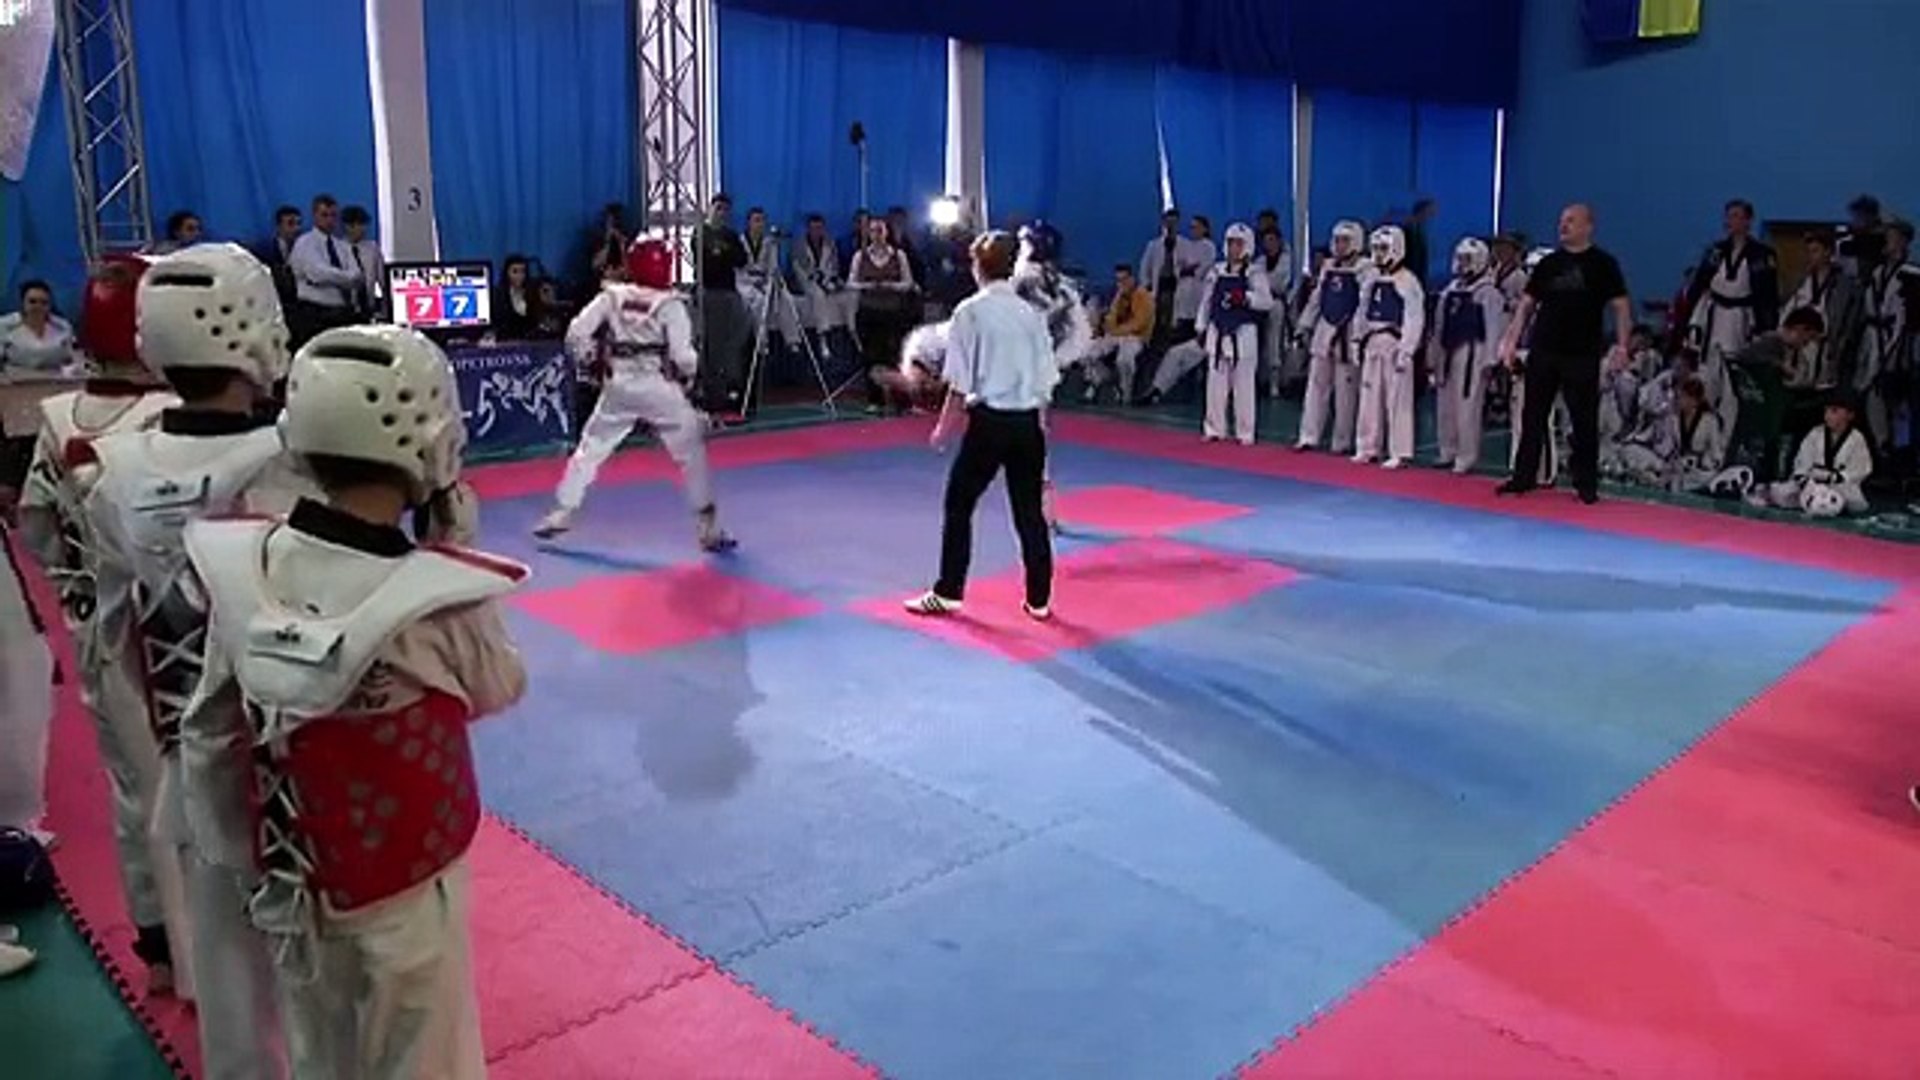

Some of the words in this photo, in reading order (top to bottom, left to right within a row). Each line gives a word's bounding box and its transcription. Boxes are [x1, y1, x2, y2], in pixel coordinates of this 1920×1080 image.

[408, 186, 421, 211] 3
[413, 295, 433, 316] 7
[450, 295, 469, 315] 7
